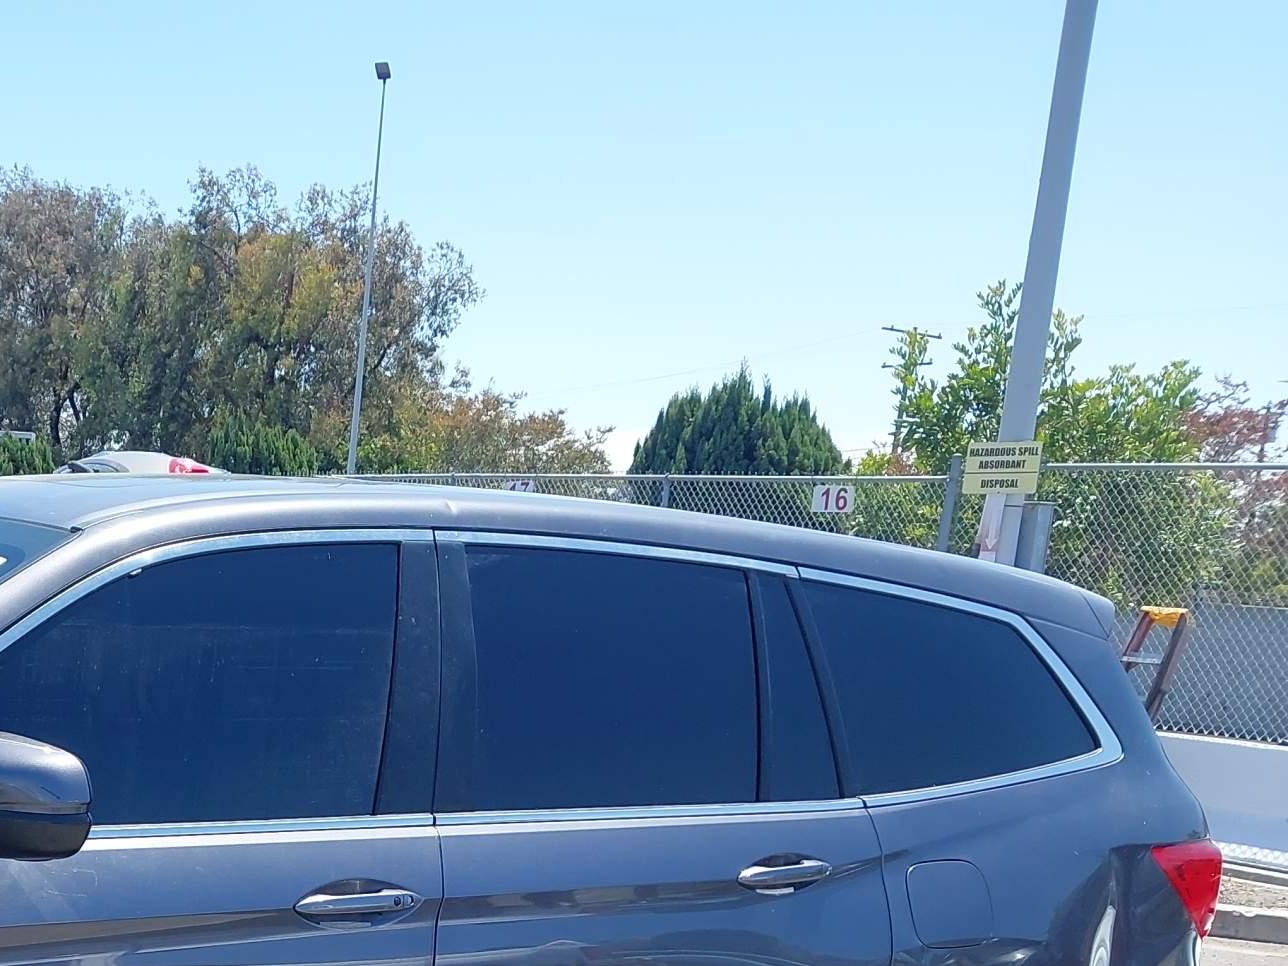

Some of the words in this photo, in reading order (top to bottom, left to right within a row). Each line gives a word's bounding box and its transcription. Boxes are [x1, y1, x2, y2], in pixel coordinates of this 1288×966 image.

[969, 447, 1016, 457] HAZARDOUS
[1018, 446, 1039, 456] SPILL
[978, 460, 1026, 469] ABSORBANT
[980, 479, 1019, 488] DISPOSAL
[821, 487, 848, 511] 16
